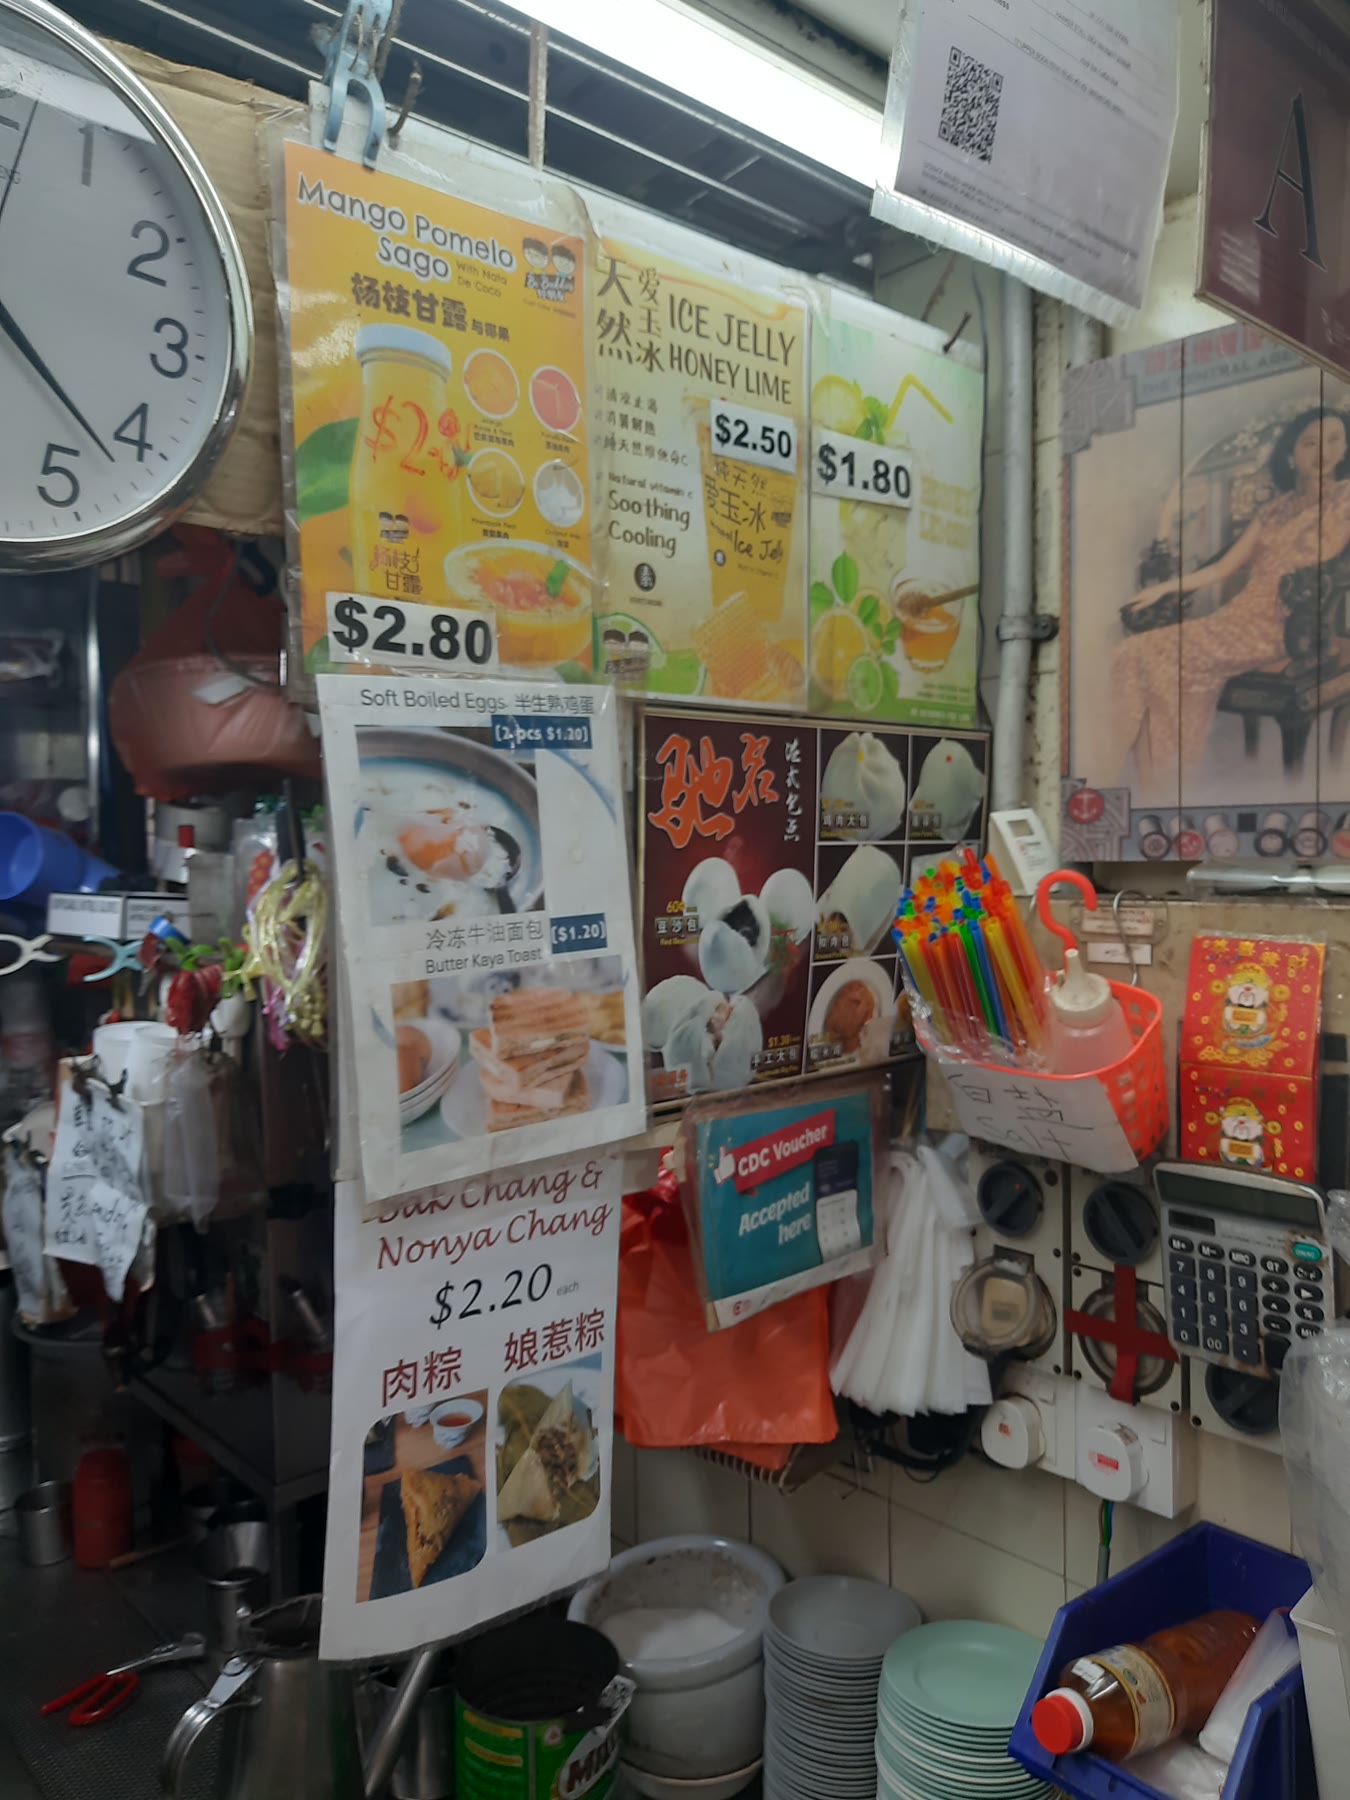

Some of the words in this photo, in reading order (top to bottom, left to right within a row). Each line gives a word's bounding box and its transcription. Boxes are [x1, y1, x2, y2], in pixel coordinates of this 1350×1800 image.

[80, 124, 95, 188] 1
[1252, 88, 1327, 273] A
[297, 174, 406, 232] Mango
[414, 214, 514, 269] Pomelo
[128, 219, 170, 287] 2
[378, 236, 449, 279] Sago
[351, 272, 468, 333] 杨枝甘露
[669, 293, 710, 340] ICE
[716, 312, 797, 367] JELLY
[150, 317, 190, 379] 3
[669, 342, 741, 390] HONEY
[745, 366, 793, 406] LIME
[114, 402, 154, 463] 4
[714, 413, 793, 459] $2.50
[37, 442, 81, 508] 5
[817, 442, 912, 500] $1.80
[608, 489, 691, 532] Soothing
[608, 519, 677, 559] Cooling
[331, 596, 493, 666] $2.80
[360, 689, 399, 707] Soft
[404, 690, 460, 709] Boiled
[466, 692, 506, 714] Eggs
[425, 956, 468, 974] Butter
[472, 952, 504, 968] Kaya
[508, 948, 543, 963] Toast
[552, 920, 607, 945] [$1.20]
[737, 1147, 771, 1178] CDC
[771, 1124, 829, 1162] Voucher
[460, 1165, 577, 1209] Chang
[581, 1160, 603, 1190] &
[738, 1181, 811, 1238] Accepted
[377, 1227, 503, 1270] Nonya
[507, 1203, 613, 1243] Chang
[777, 1212, 813, 1246] here
[1176, 1261, 1185, 1272] 7
[1177, 1285, 1186, 1296] 4
[1238, 1276, 1247, 1288] 9
[429, 1262, 553, 1330] $2.20
[1239, 1300, 1248, 1312] 6
[503, 1307, 605, 1374] 娘惹粽
[1206, 1337, 1223, 1351] 00
[1240, 1323, 1248, 1336] 3
[381, 1345, 463, 1408] 肉粽
